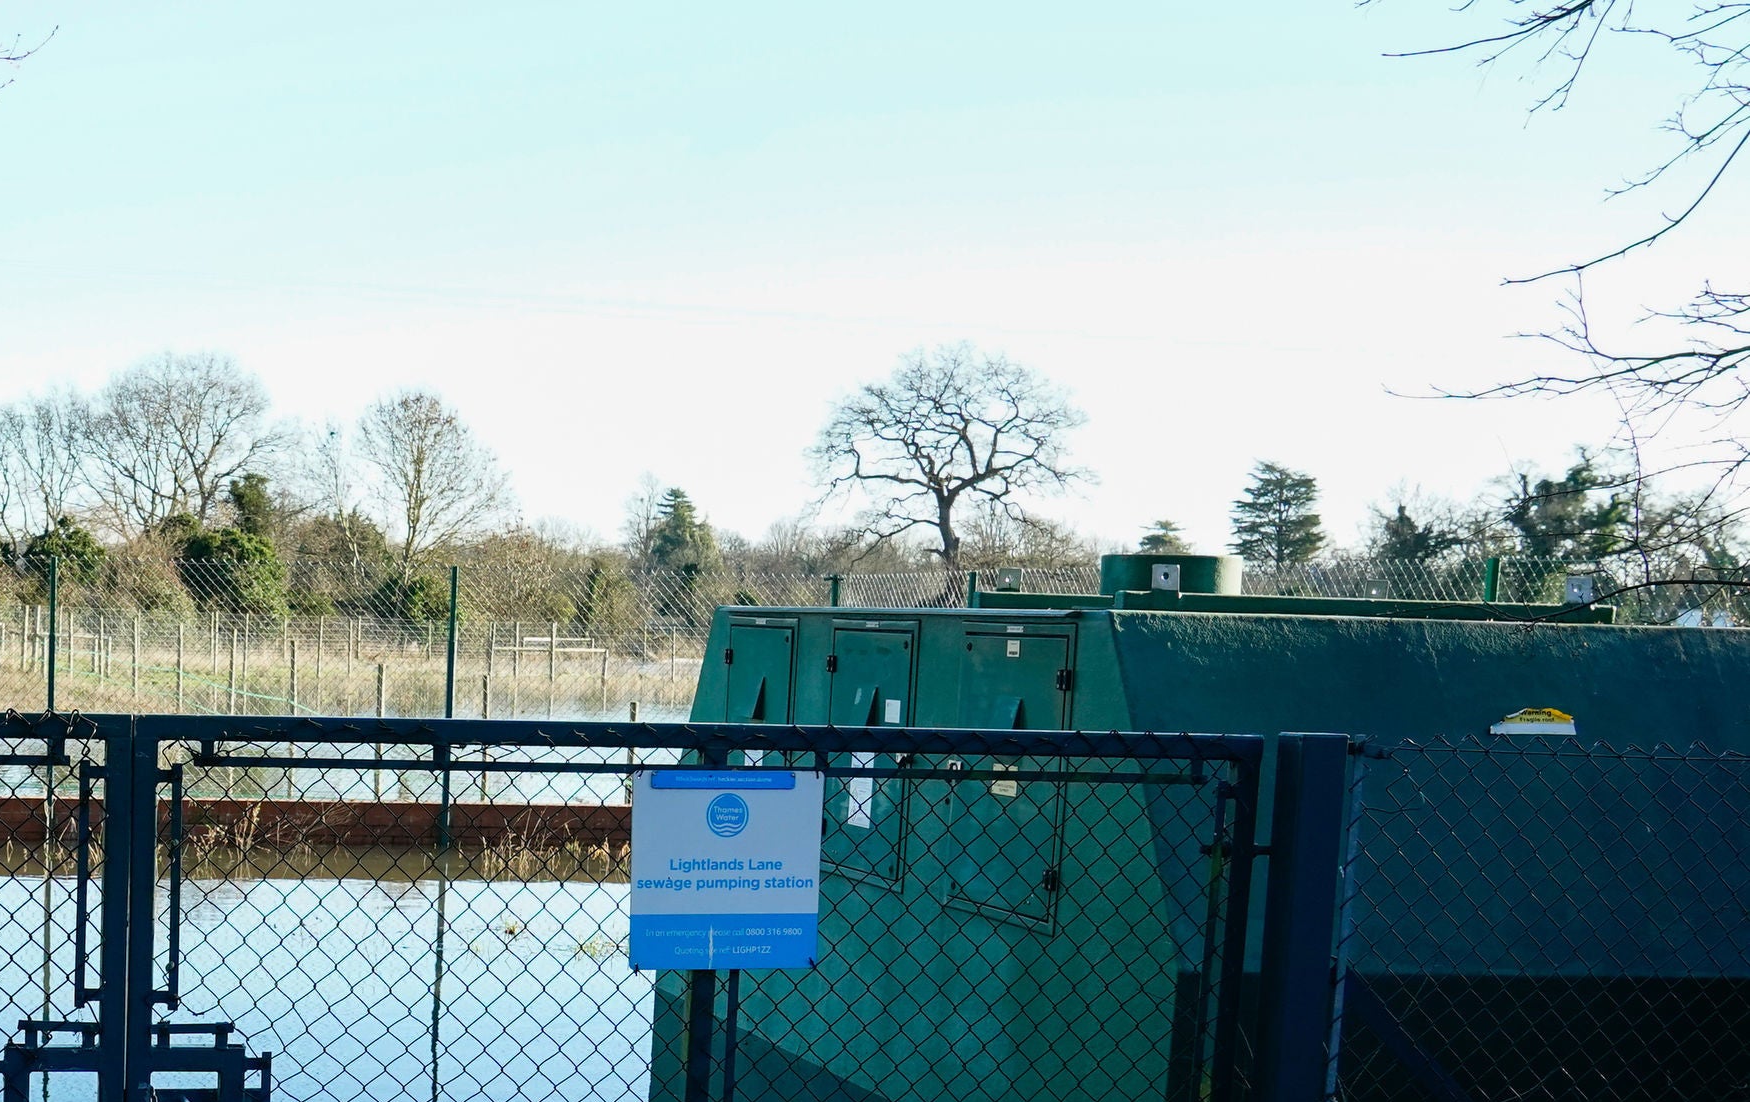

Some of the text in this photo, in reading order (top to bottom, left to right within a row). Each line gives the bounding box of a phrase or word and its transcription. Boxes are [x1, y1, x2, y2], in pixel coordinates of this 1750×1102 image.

[713, 805, 743, 814] Thames
[715, 813, 740, 821] Water
[669, 858, 783, 873] Lightlands Lane
[636, 876, 814, 891] sewage pumping station
[645, 928, 655, 937] In
[666, 929, 707, 939] emergency
[732, 927, 745, 936] call
[745, 927, 765, 936] 0800
[766, 927, 782, 936] 316
[782, 927, 803, 936] 9800
[674, 945, 704, 957] Quoting
